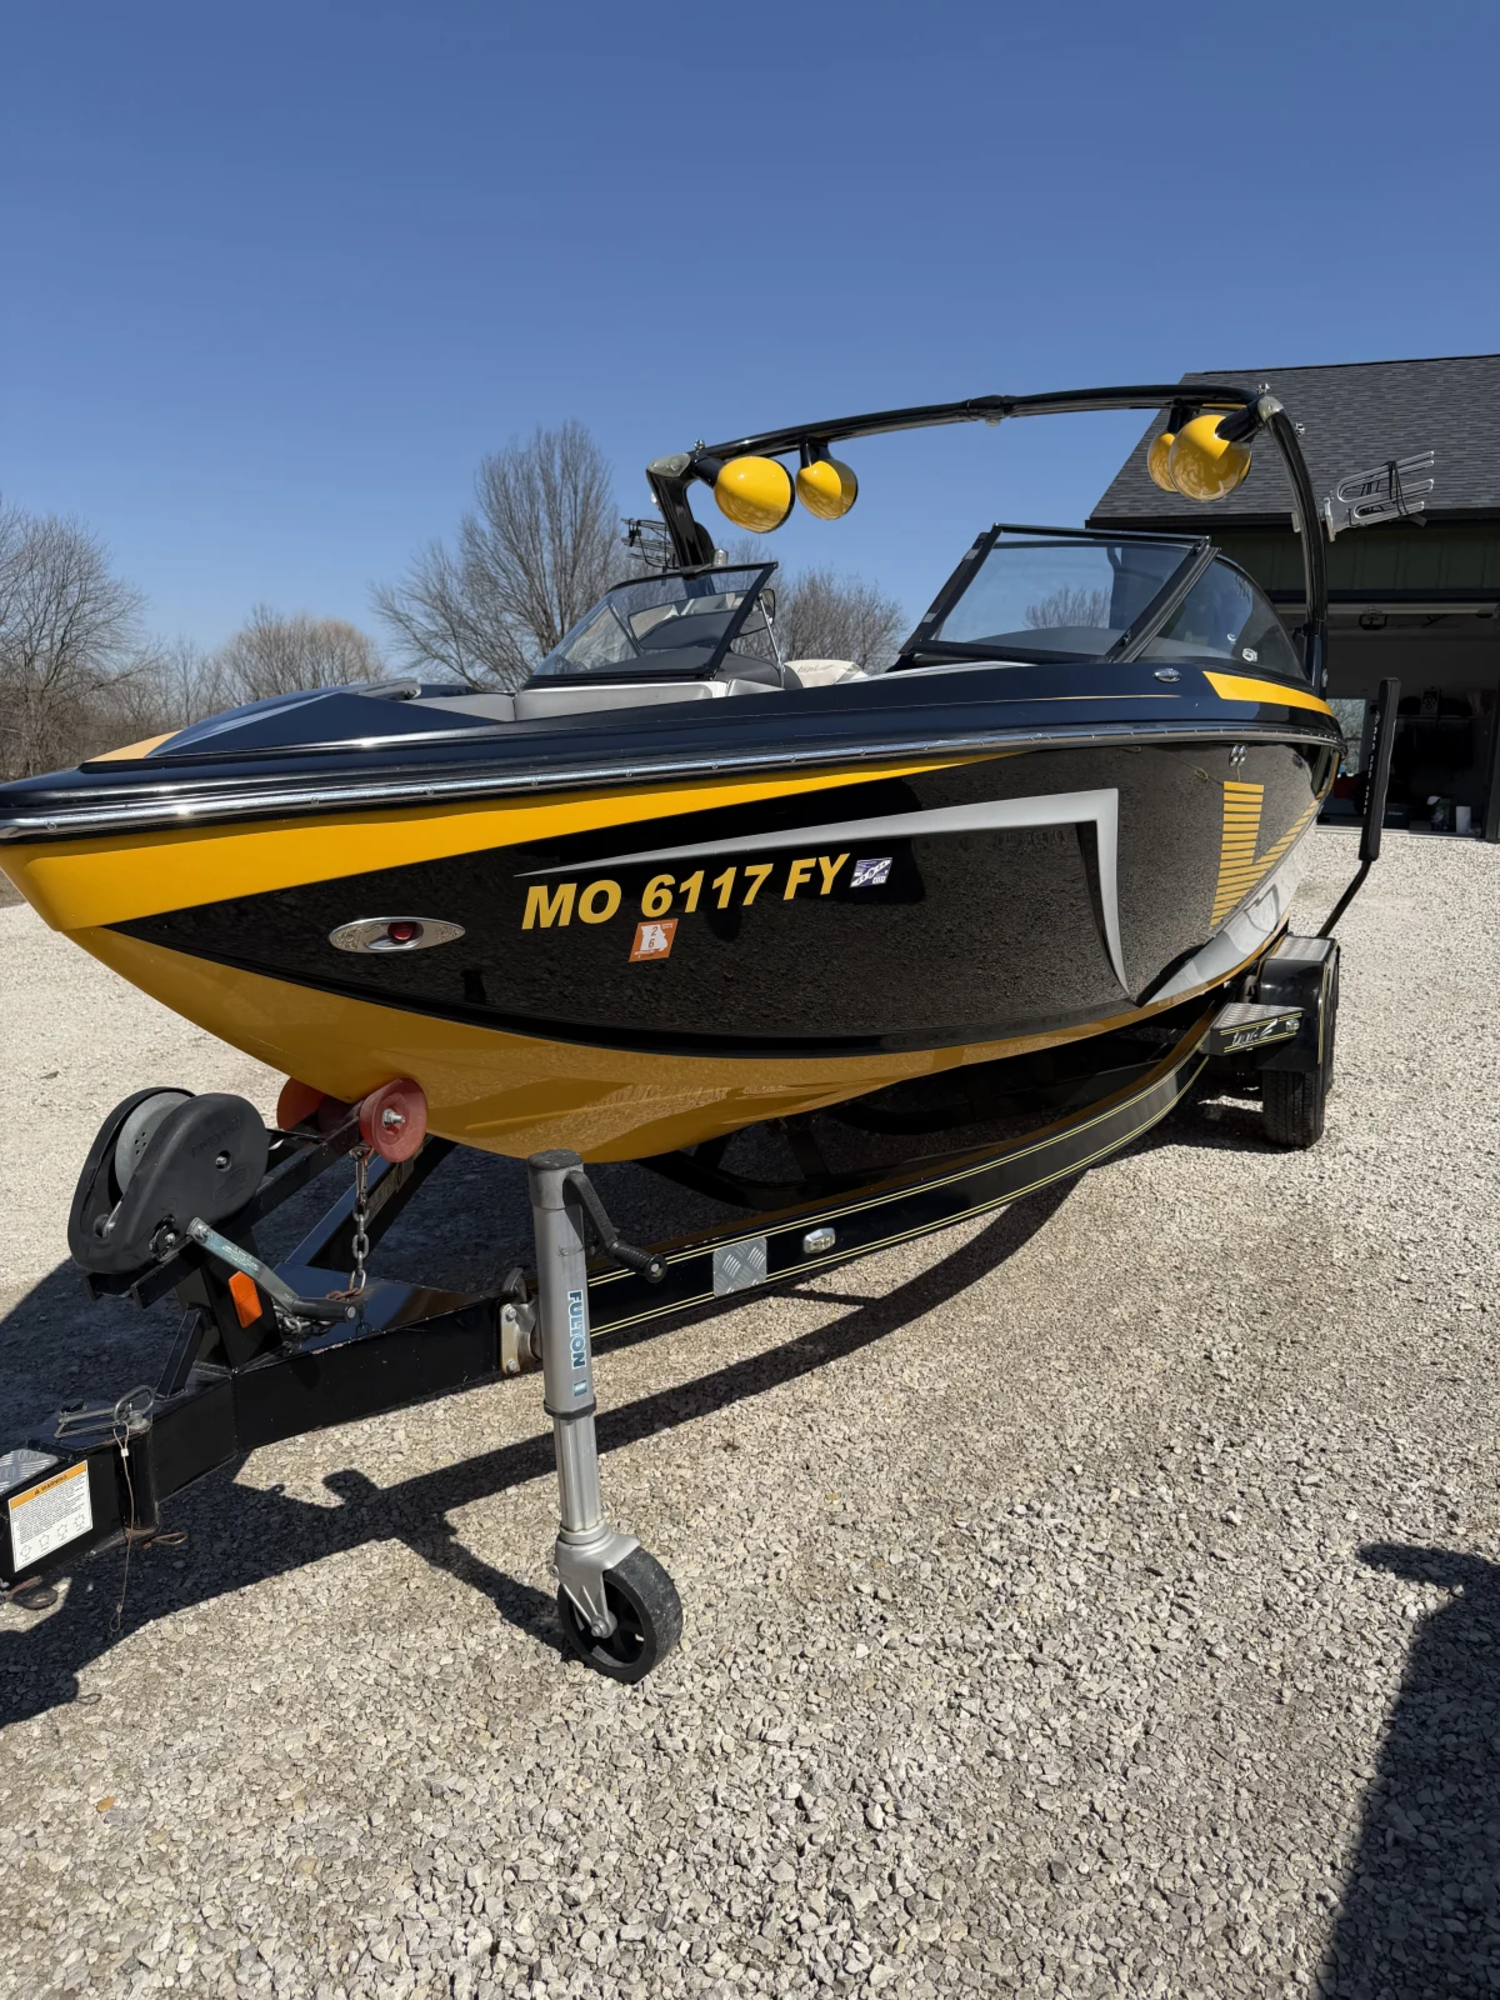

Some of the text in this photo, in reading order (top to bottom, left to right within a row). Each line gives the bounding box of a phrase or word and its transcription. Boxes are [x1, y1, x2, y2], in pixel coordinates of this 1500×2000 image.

[521, 853, 851, 930] MO 6117 FY
[568, 1290, 587, 1369] FULTON
